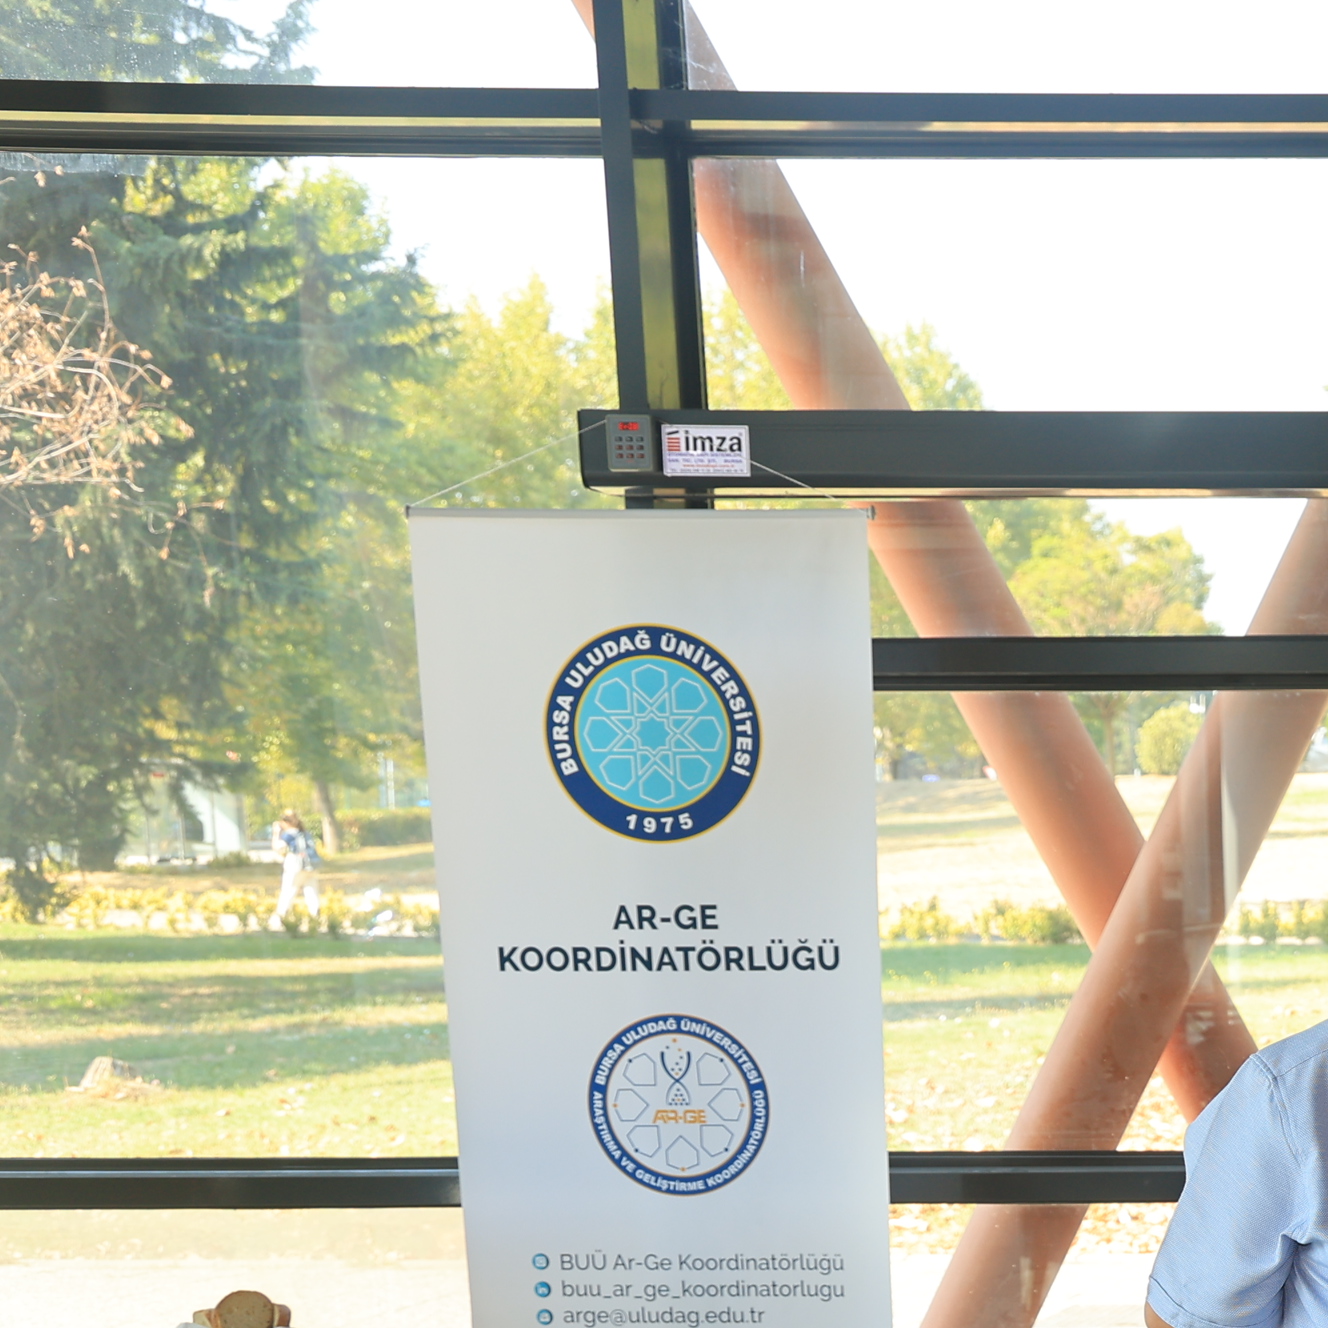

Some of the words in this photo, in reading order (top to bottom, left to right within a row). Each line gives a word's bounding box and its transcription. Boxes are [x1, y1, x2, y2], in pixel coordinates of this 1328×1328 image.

[684, 430, 742, 452] imza
[564, 629, 651, 688] ULUDAĞ
[659, 633, 753, 777] ÜNİVERSİTESİ
[552, 695, 579, 775] BURSA
[626, 813, 693, 833] 1975
[613, 904, 719, 930] AR-GE
[498, 938, 840, 972] KOORDİNATÖRLÜĞÜ
[595, 1043, 625, 1085] BURSA
[622, 1018, 677, 1045] ULUDAĞ
[680, 1019, 763, 1084] ÜNİVERSİTESİ
[652, 1109, 707, 1124] AR-GE
[593, 1091, 621, 1160] ARAŞTIRMA
[620, 1158, 637, 1172] VE
[635, 1169, 706, 1191] GELİŞTİRME
[706, 1090, 766, 1186] KOORDİNATÖRLÜĞÜ
[560, 1250, 607, 1271] BUÜ
[613, 1254, 672, 1272] Ar-Ge
[679, 1253, 844, 1275] Koordinatörlüğü
[561, 1280, 845, 1301] buu_ar_ge_koordinatorlugu
[563, 1306, 765, 1327] arge@uludag.edu.tr
